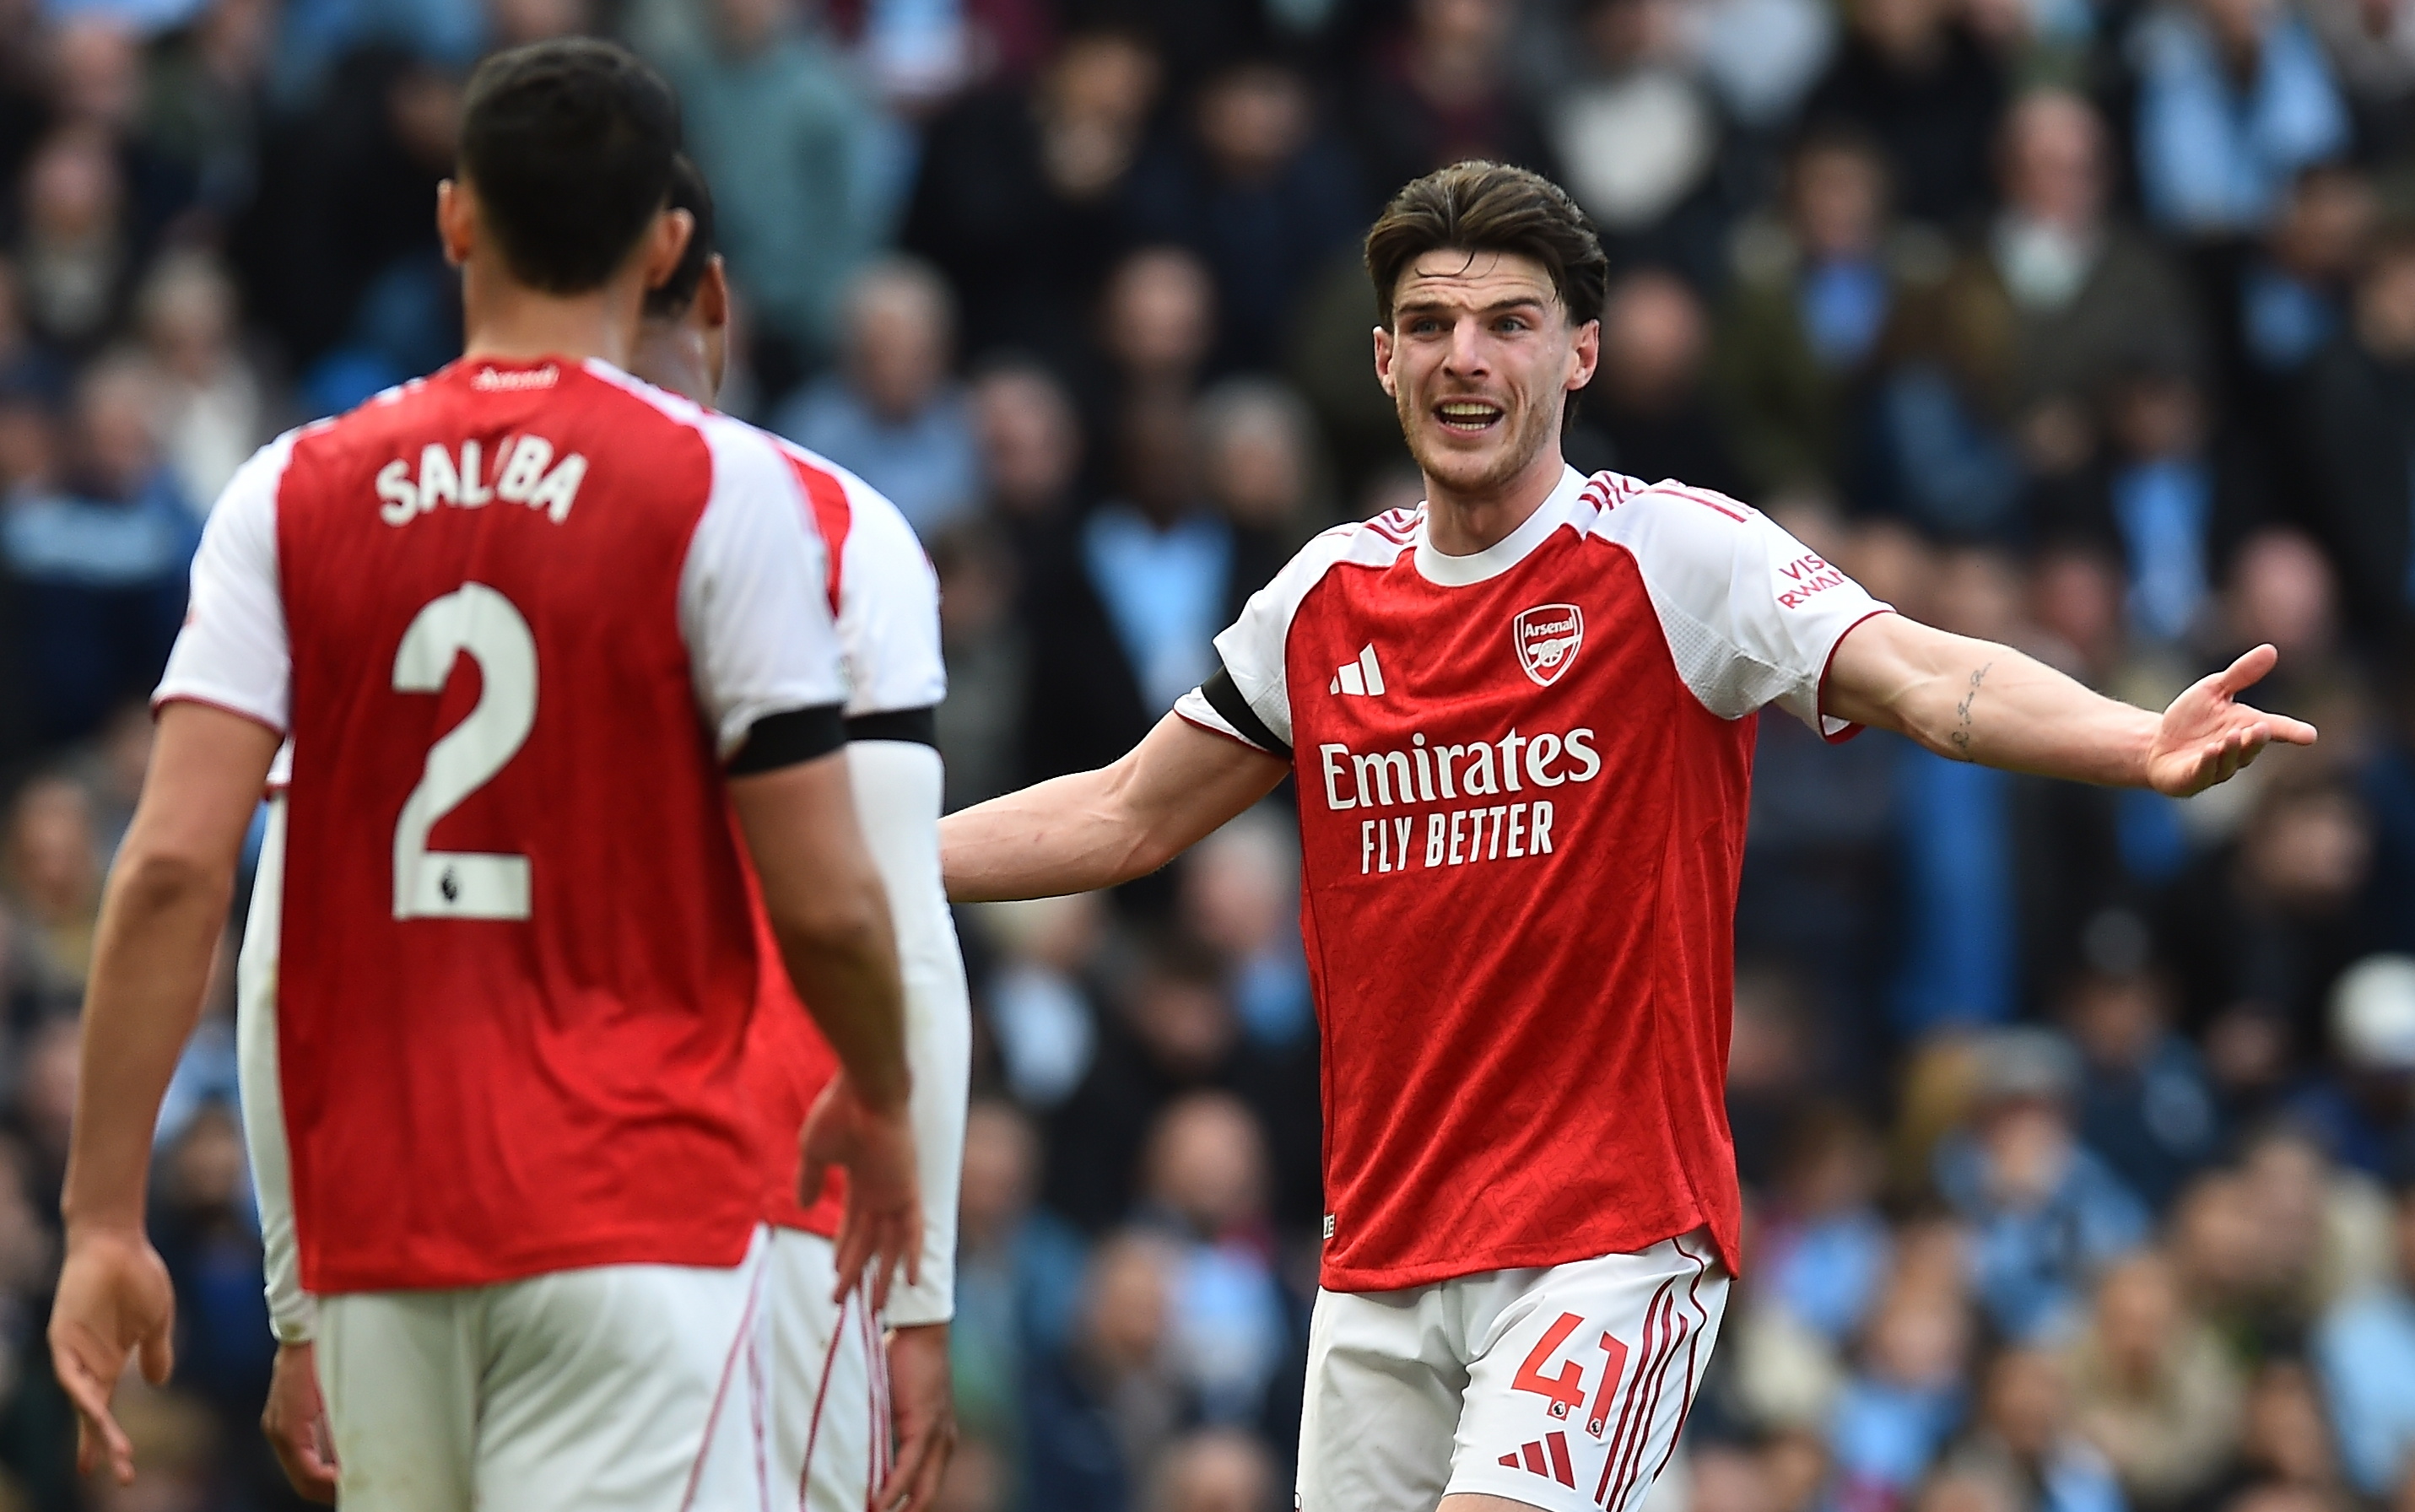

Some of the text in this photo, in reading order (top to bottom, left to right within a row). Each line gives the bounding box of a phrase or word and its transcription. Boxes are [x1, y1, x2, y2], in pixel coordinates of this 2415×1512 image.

[1524, 616, 1575, 639] Arsenal
[392, 580, 542, 921] 2
[1319, 726, 1602, 810] Emirates
[1361, 800, 1553, 875] FLY BETTER
[1510, 1311, 1629, 1440] 41
